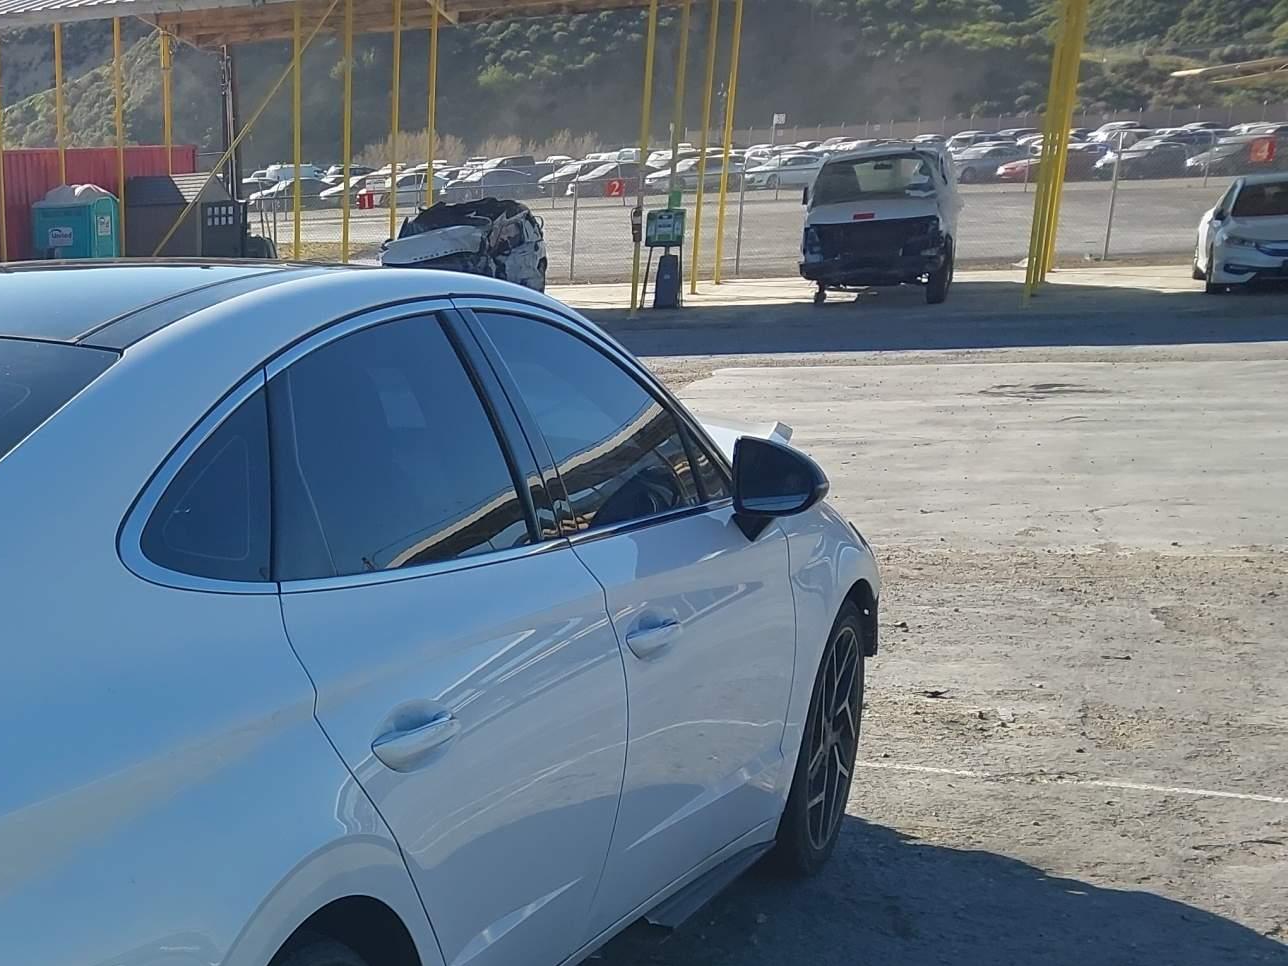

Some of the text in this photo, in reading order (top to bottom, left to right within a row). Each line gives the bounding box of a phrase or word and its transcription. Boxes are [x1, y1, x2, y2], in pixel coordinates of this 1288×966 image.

[1256, 140, 1270, 160] 4
[610, 180, 620, 196] 2
[363, 194, 370, 208] 1
